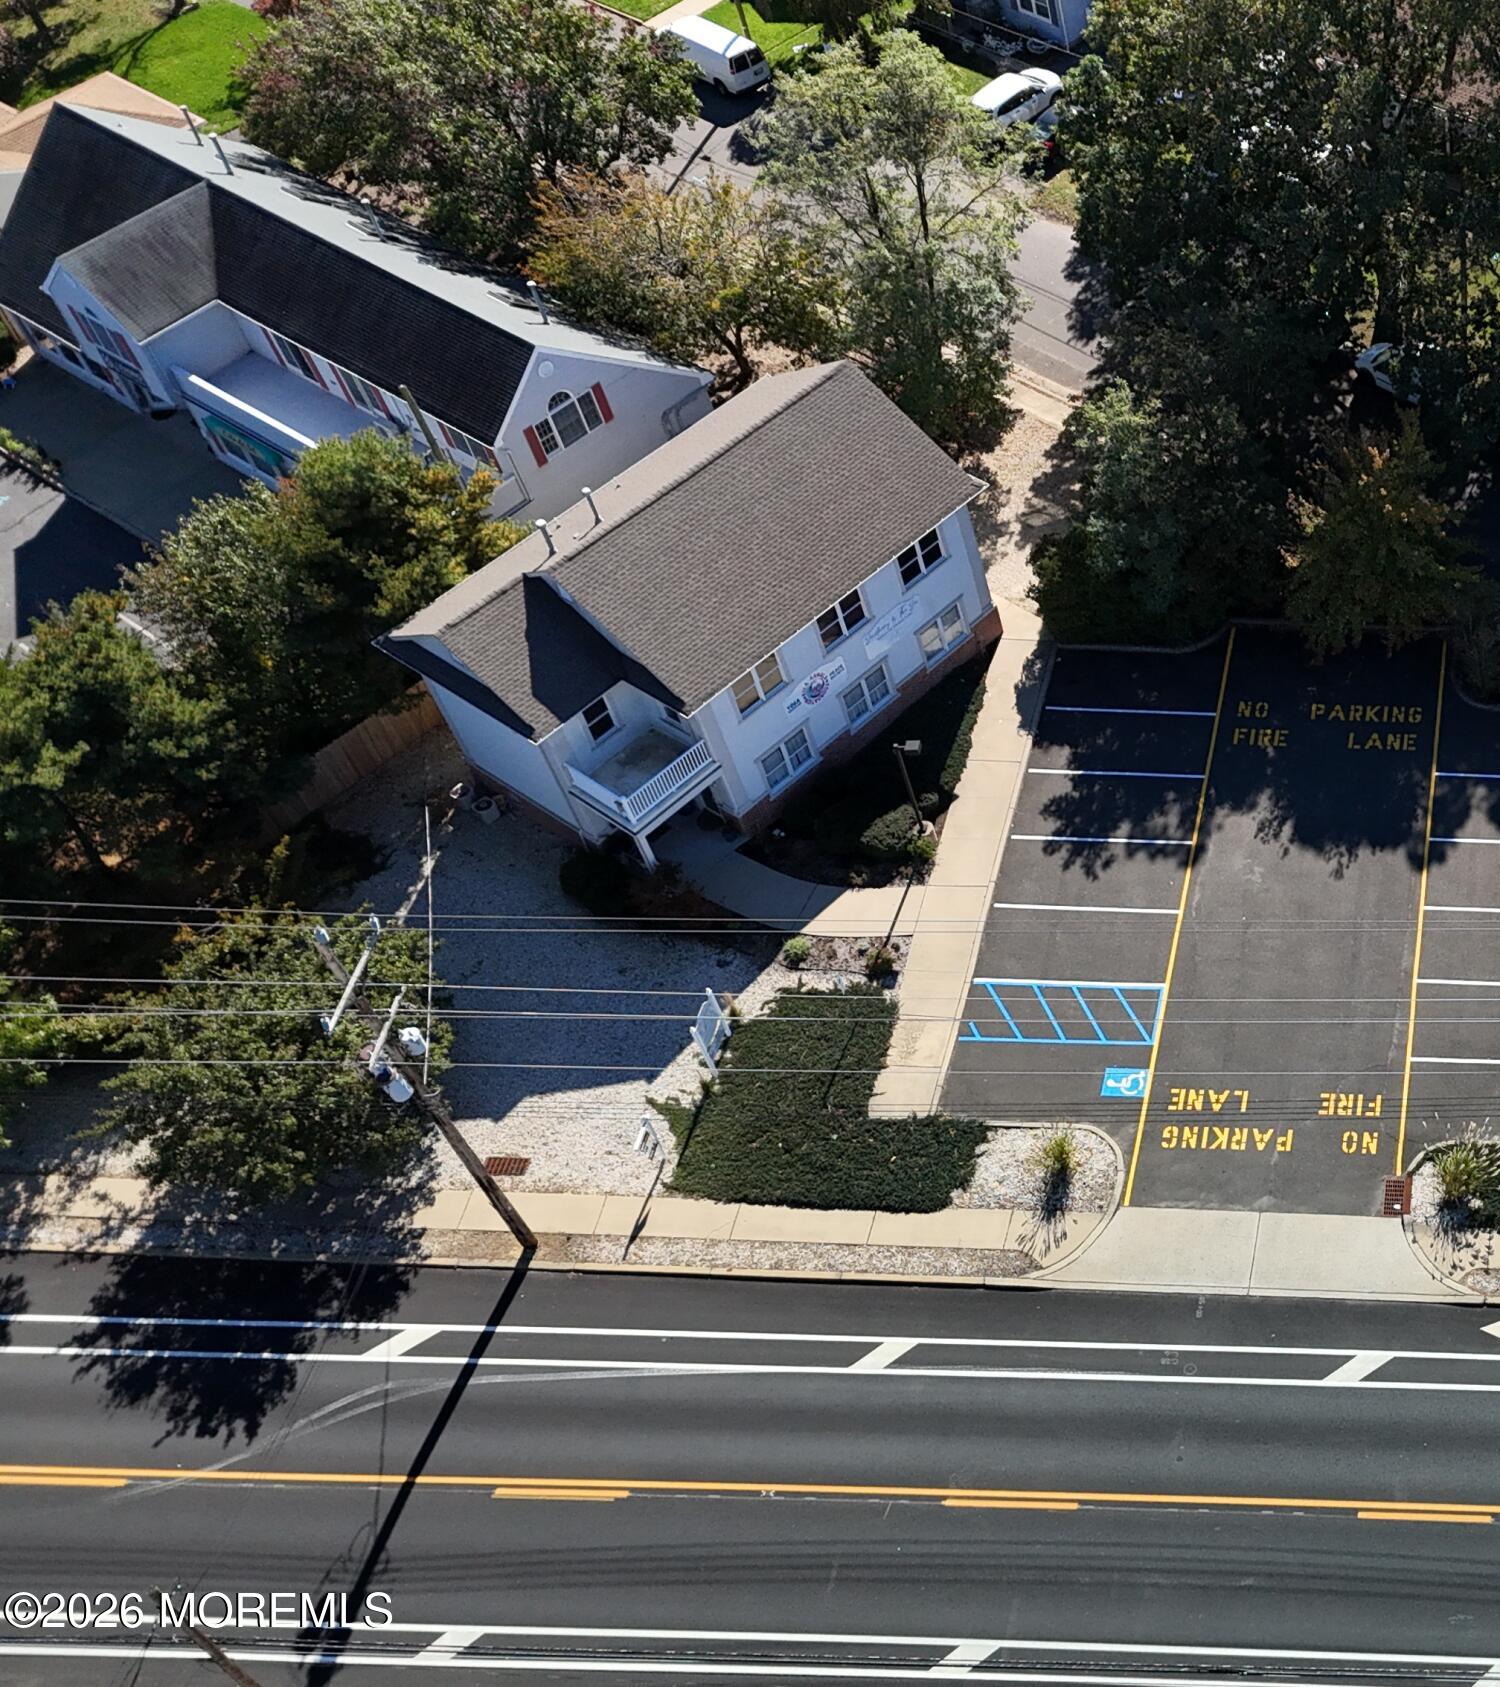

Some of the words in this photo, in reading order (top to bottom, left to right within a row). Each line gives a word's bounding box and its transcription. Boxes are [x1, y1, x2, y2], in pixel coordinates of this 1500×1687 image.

[1237, 701, 1269, 718] NO
[1310, 703, 1422, 723] PARKING
[1232, 728, 1288, 747] FIRE
[1347, 732, 1417, 751] LANE
[1167, 1087, 1250, 1112] LANE
[1318, 1091, 1382, 1117] FIRE
[1160, 1124, 1295, 1152] PARKING
[1341, 1130, 1379, 1154] NO
